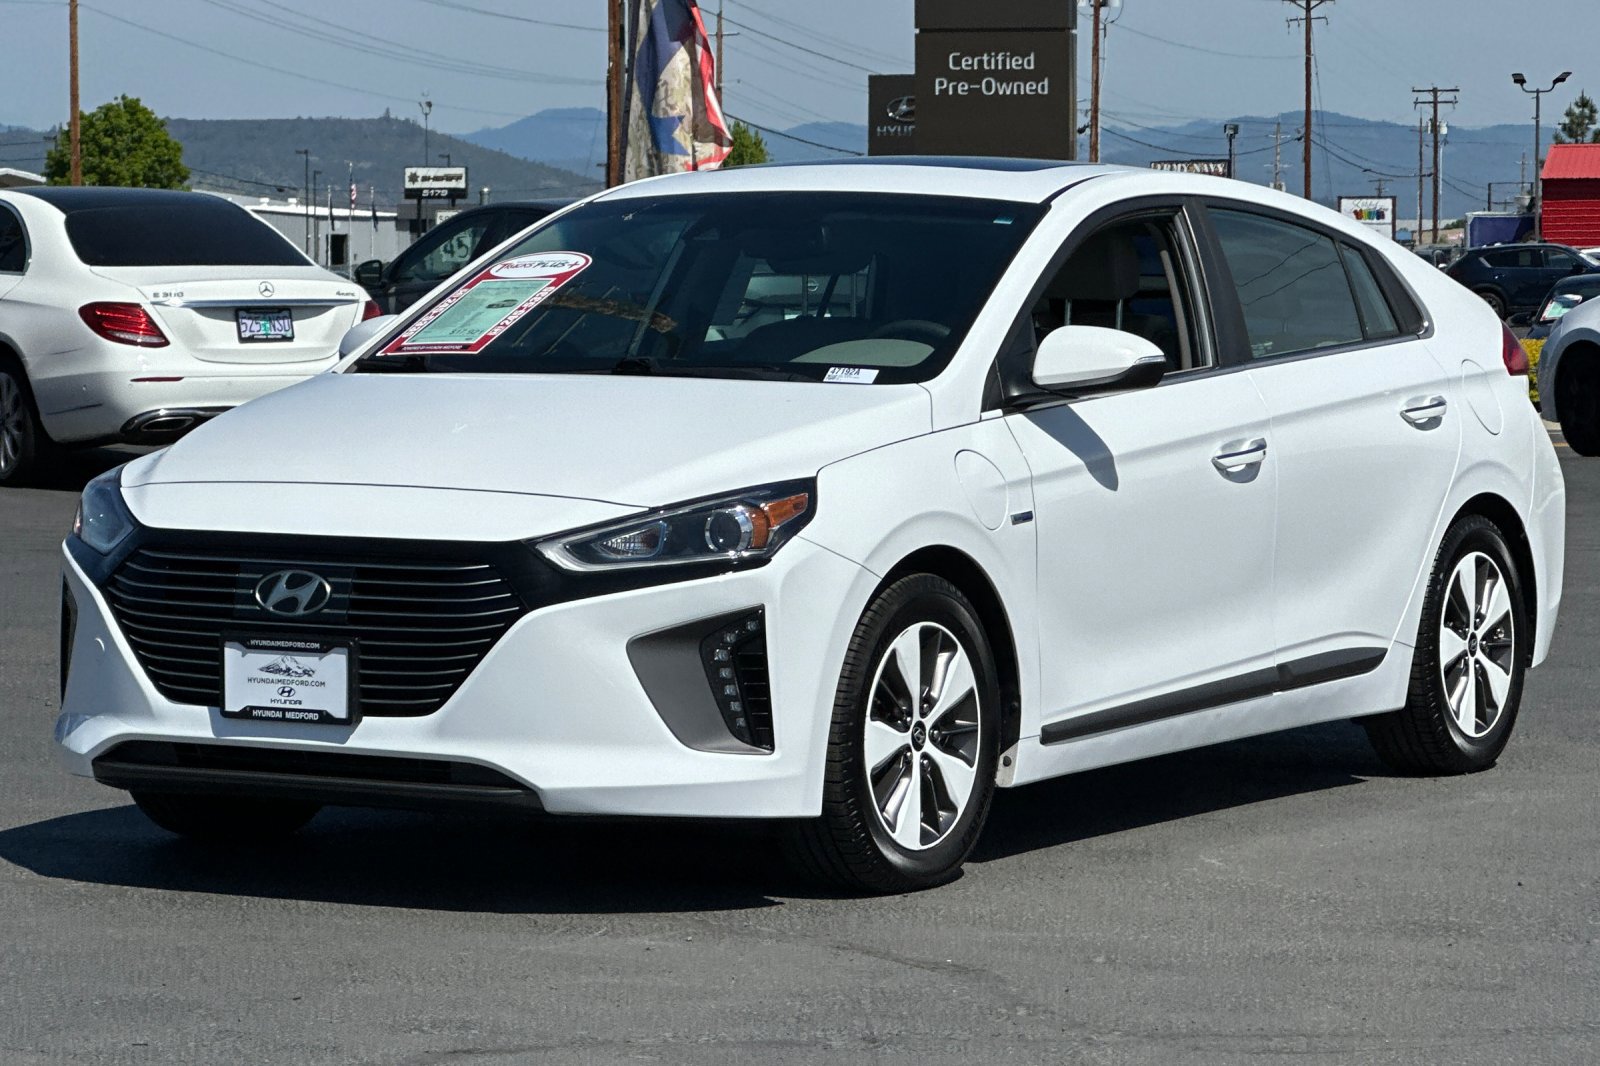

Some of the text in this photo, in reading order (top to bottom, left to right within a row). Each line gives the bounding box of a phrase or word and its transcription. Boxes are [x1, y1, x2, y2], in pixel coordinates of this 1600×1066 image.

[949, 52, 1035, 70] Certified
[935, 77, 1049, 95] Pre-Owned
[240, 316, 261, 333] 525
[250, 639, 320, 649] HYUNDAIMEDFORD.COM
[247, 677, 326, 687] HYUNDAIMEDFORD.COM
[252, 709, 319, 720] HYUNDAI MEDFORD
